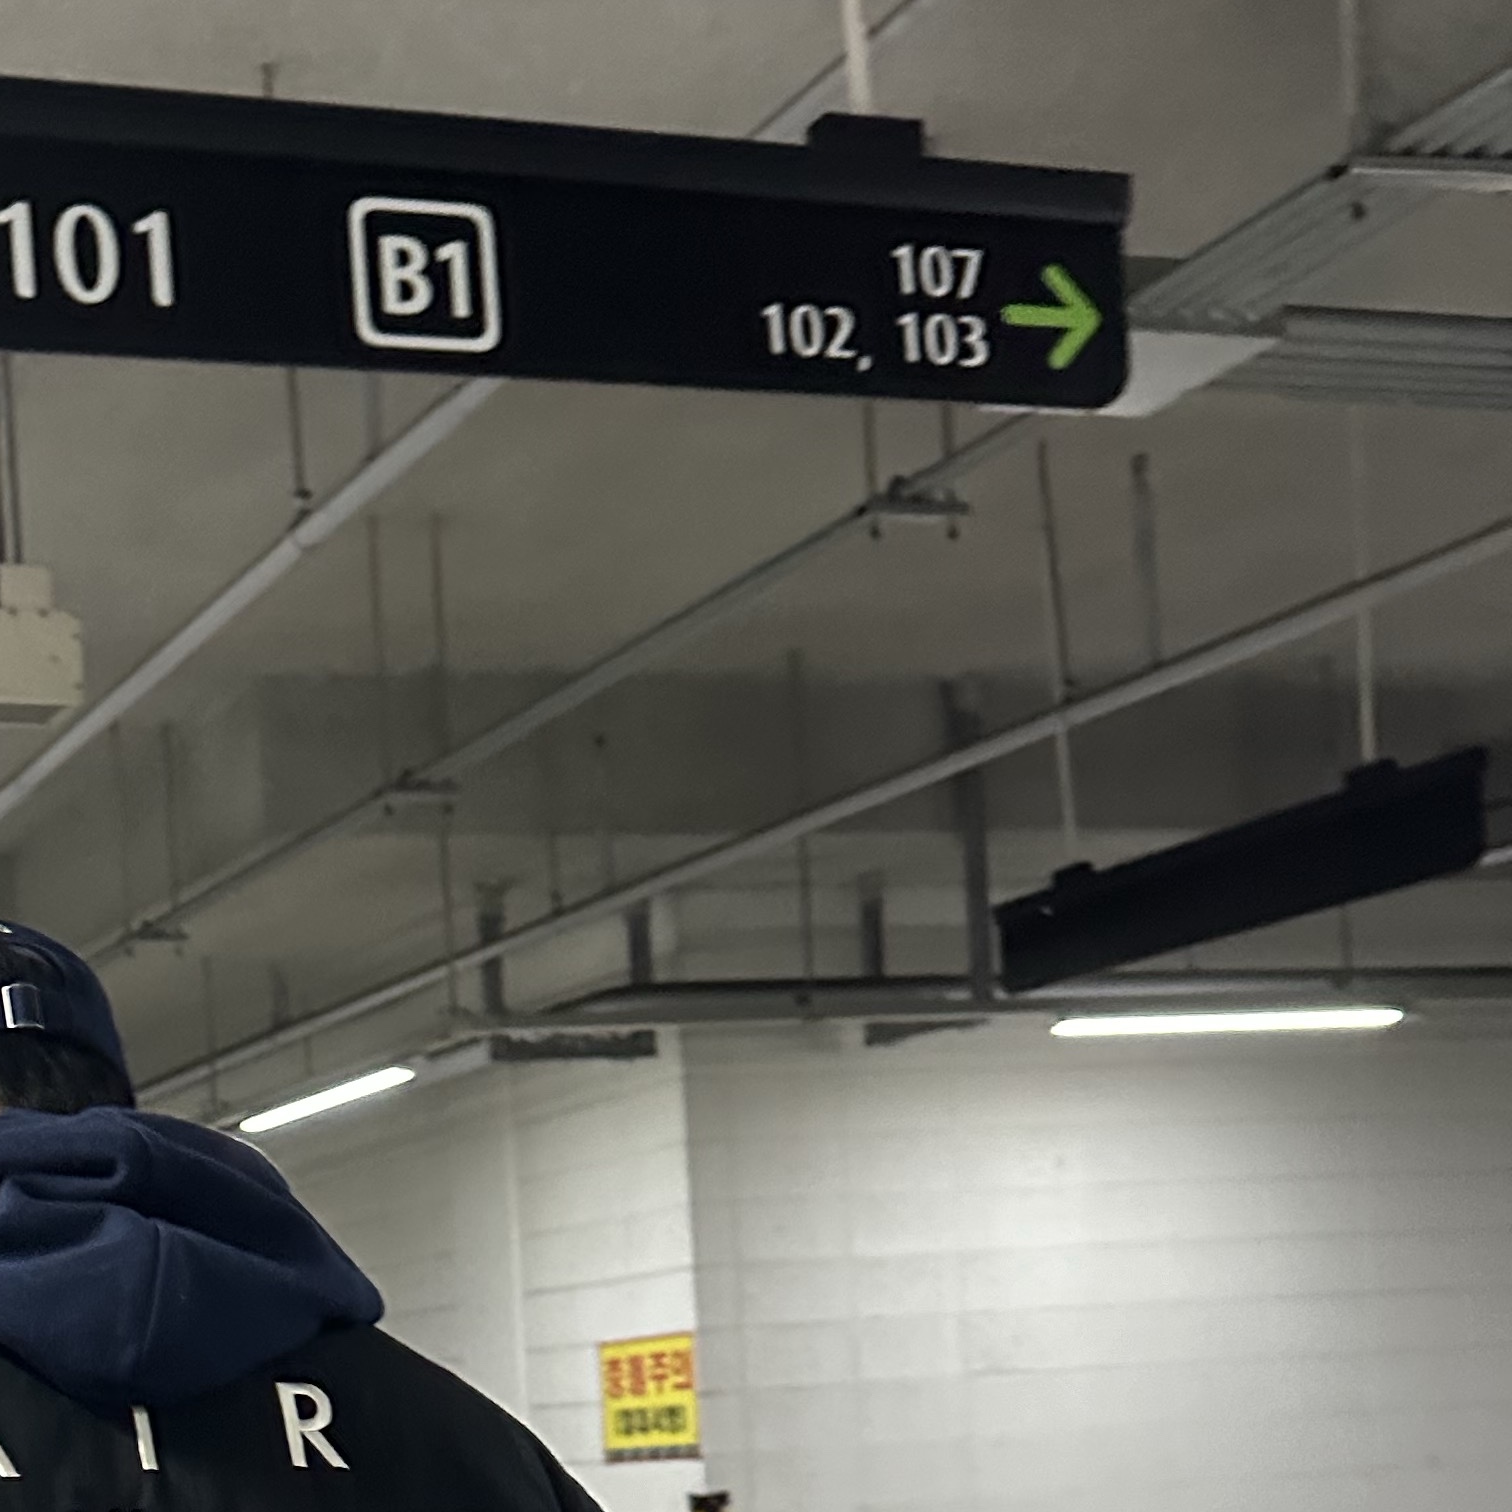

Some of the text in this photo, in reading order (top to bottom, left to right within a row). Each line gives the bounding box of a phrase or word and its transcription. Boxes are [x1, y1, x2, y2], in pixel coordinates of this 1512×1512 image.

[377, 233, 474, 319] B1
[891, 243, 985, 299] 107
[895, 311, 990, 367] 103
